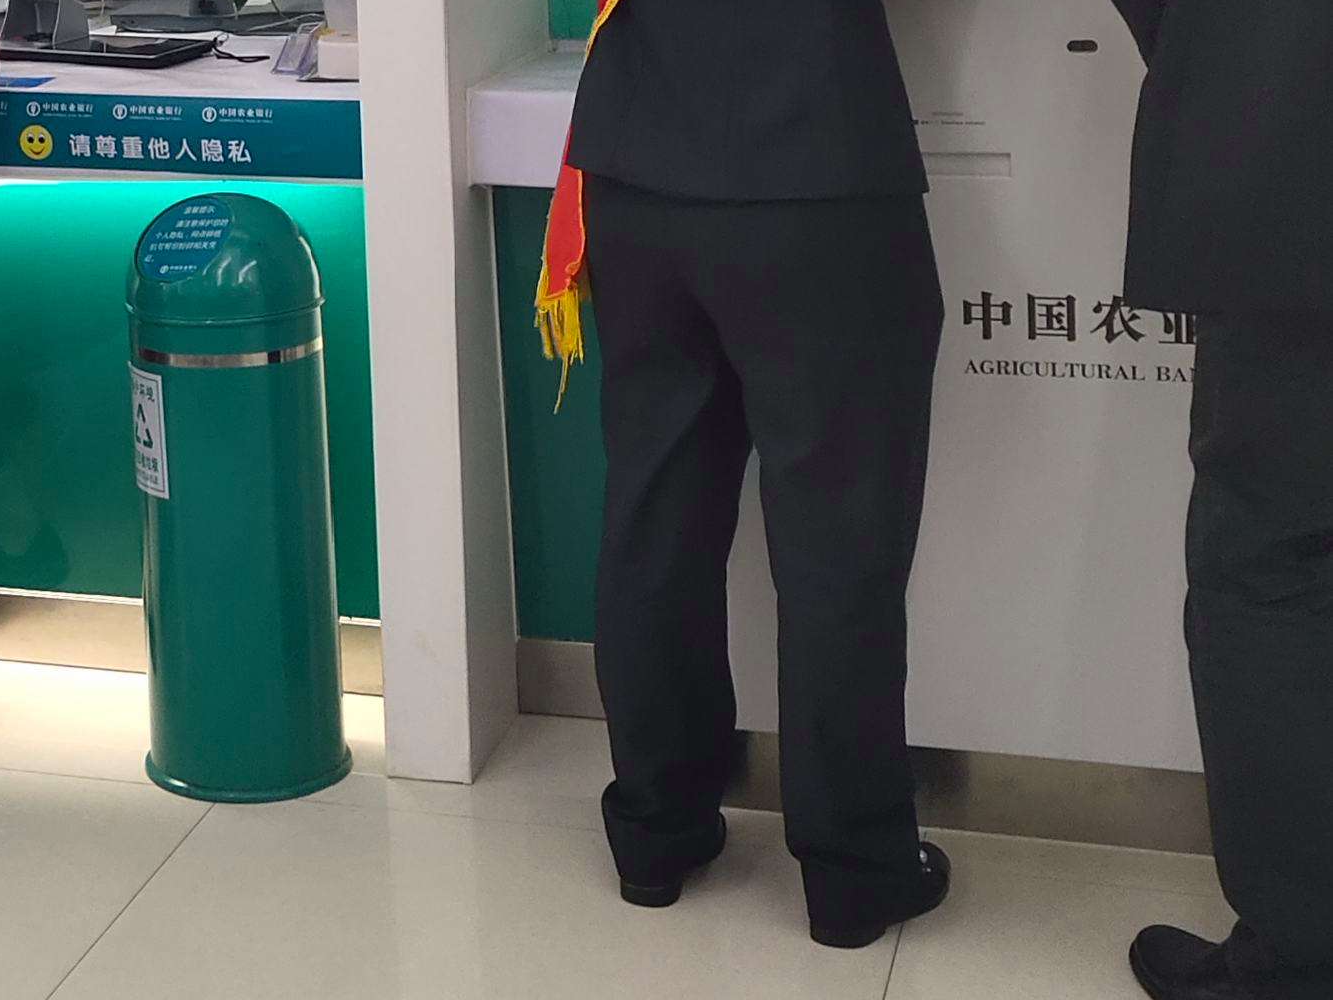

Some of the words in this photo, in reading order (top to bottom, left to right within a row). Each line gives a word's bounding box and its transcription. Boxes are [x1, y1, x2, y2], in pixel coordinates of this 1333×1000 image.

[42, 101, 94, 114] 中国农业银行
[129, 104, 183, 117] 中国农业银行
[218, 107, 273, 120] 中国农业银行
[69, 133, 252, 164] 请尊重他人隐私
[964, 359, 1146, 382] AGRICULTURAL
